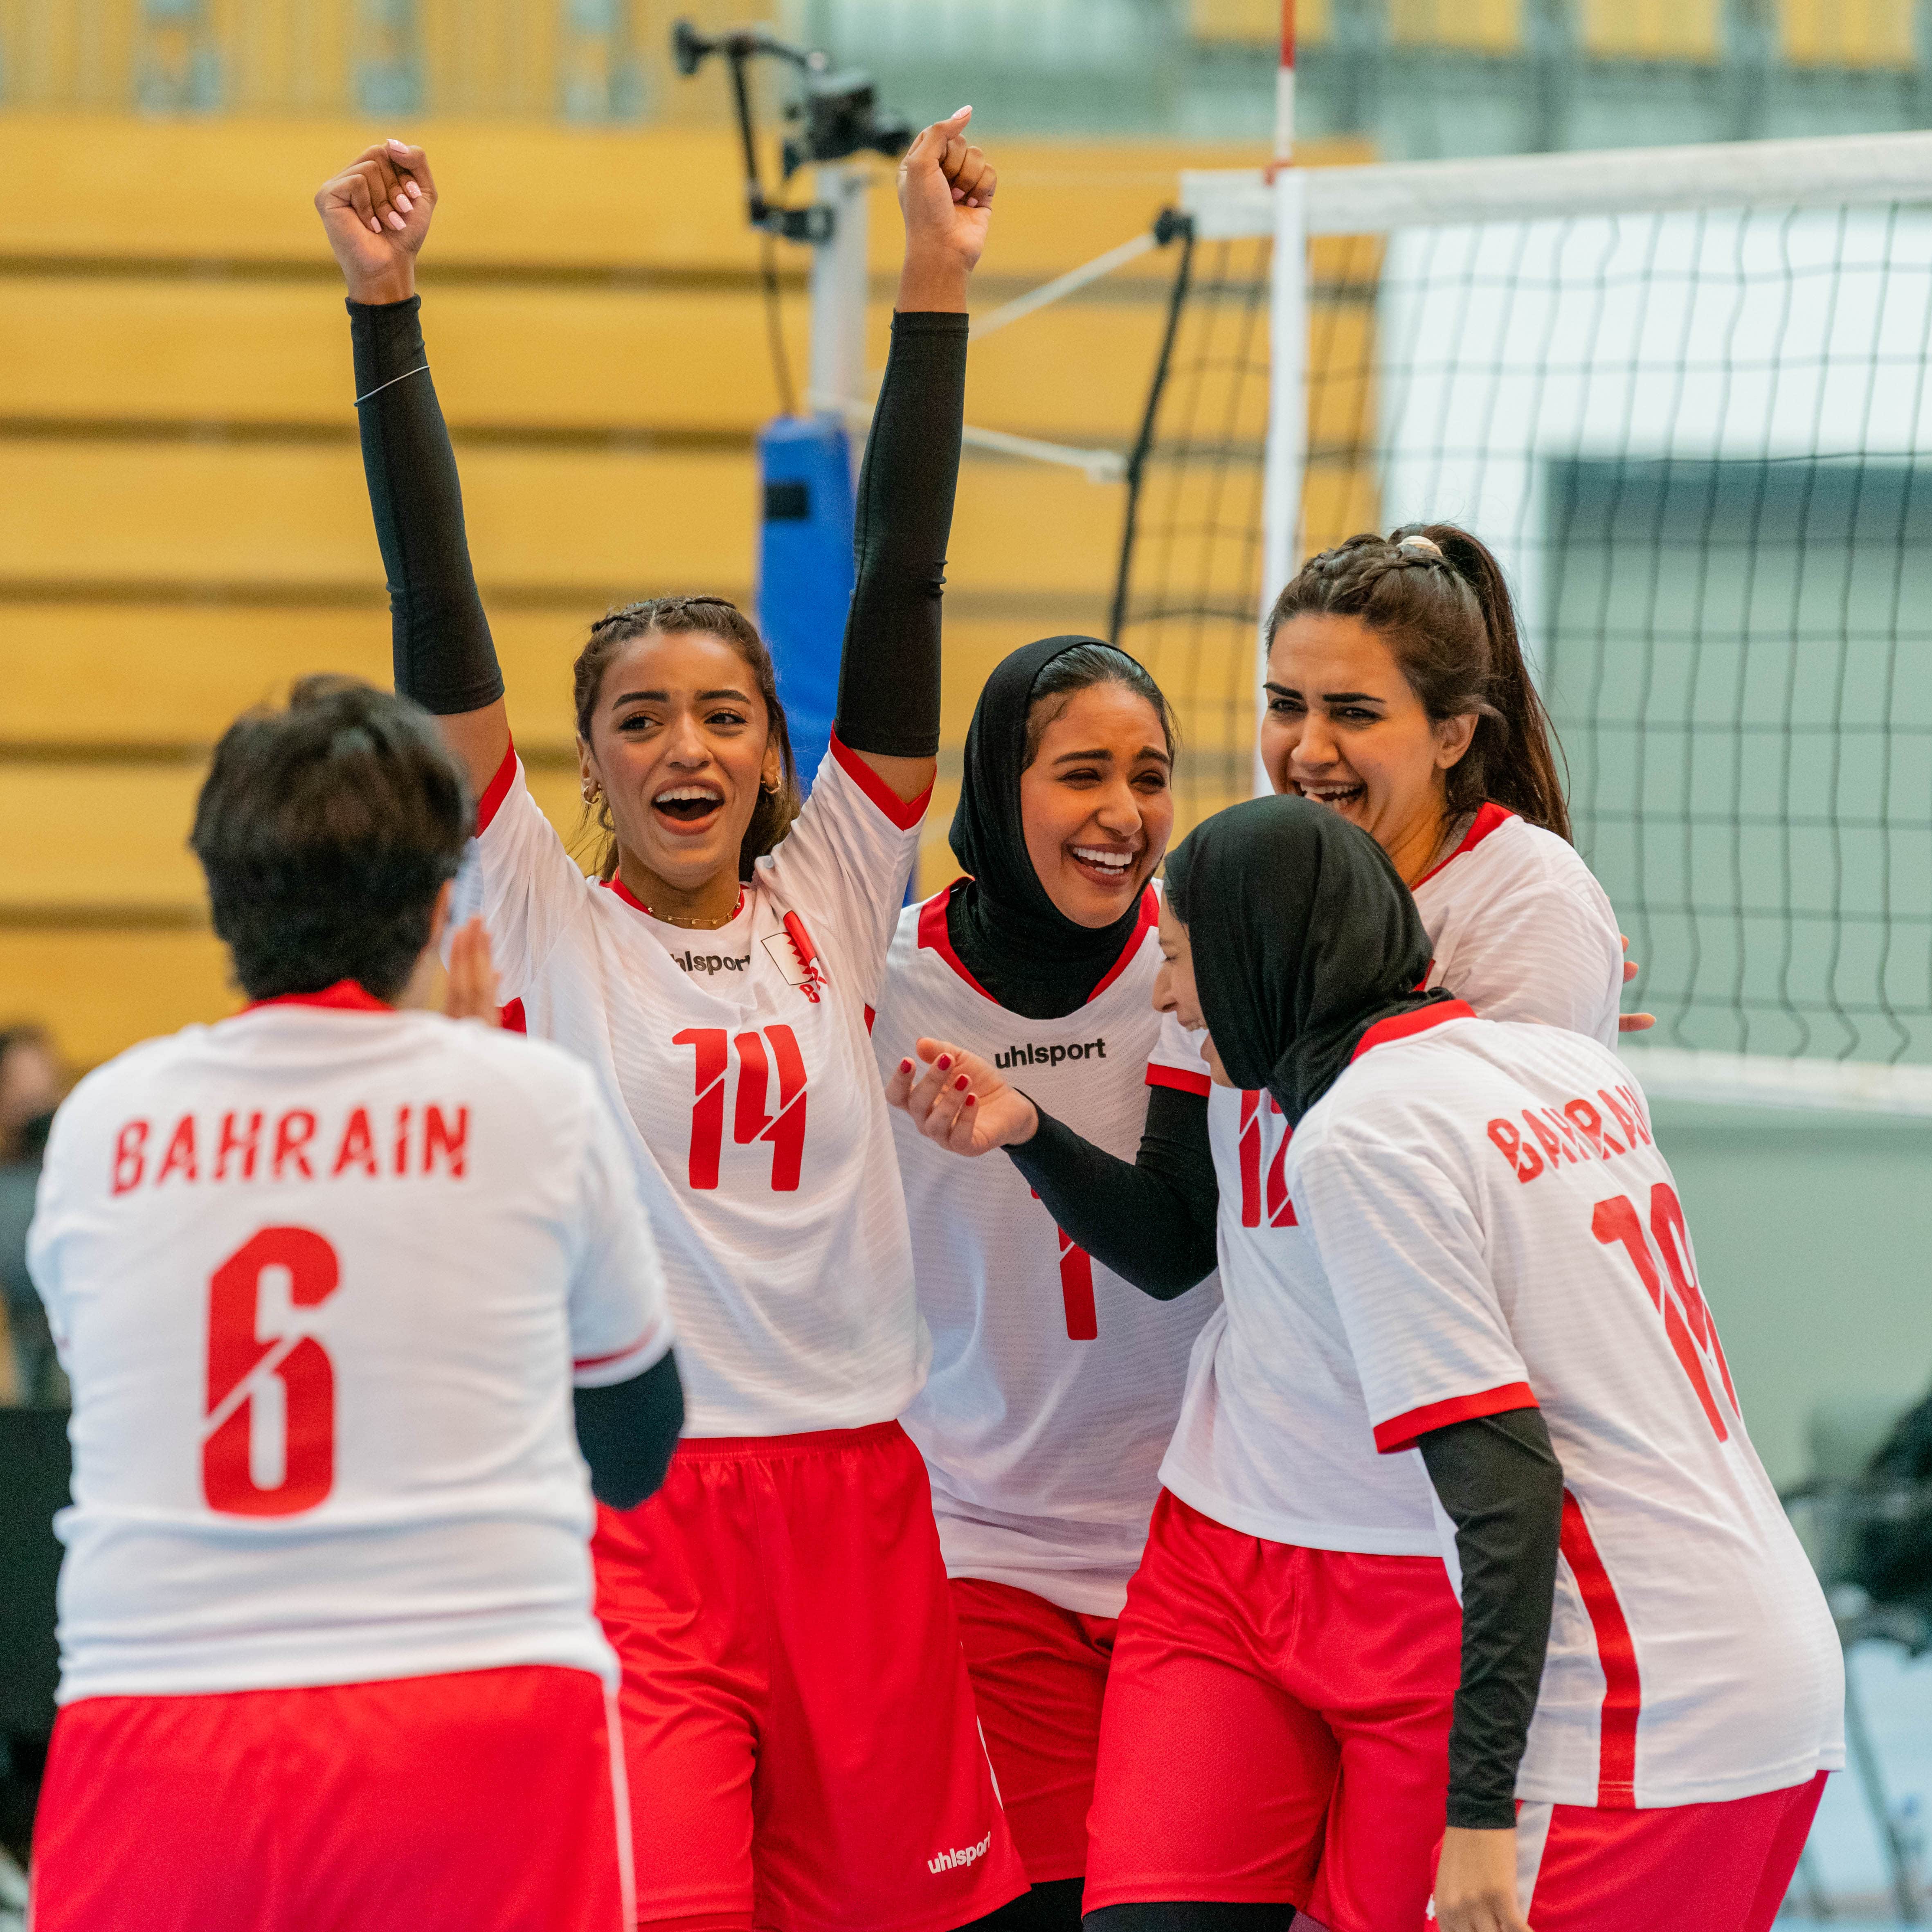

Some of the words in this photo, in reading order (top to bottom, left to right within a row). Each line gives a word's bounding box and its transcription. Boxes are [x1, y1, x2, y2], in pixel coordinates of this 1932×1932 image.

[670, 951, 751, 975] hlsport
[994, 1038, 1107, 1069] uhlsport
[671, 1024, 808, 1192] 14
[111, 1102, 470, 1197] BAHRAIN
[200, 1224, 342, 1521] 6
[927, 1831, 991, 1874] uhlsport
